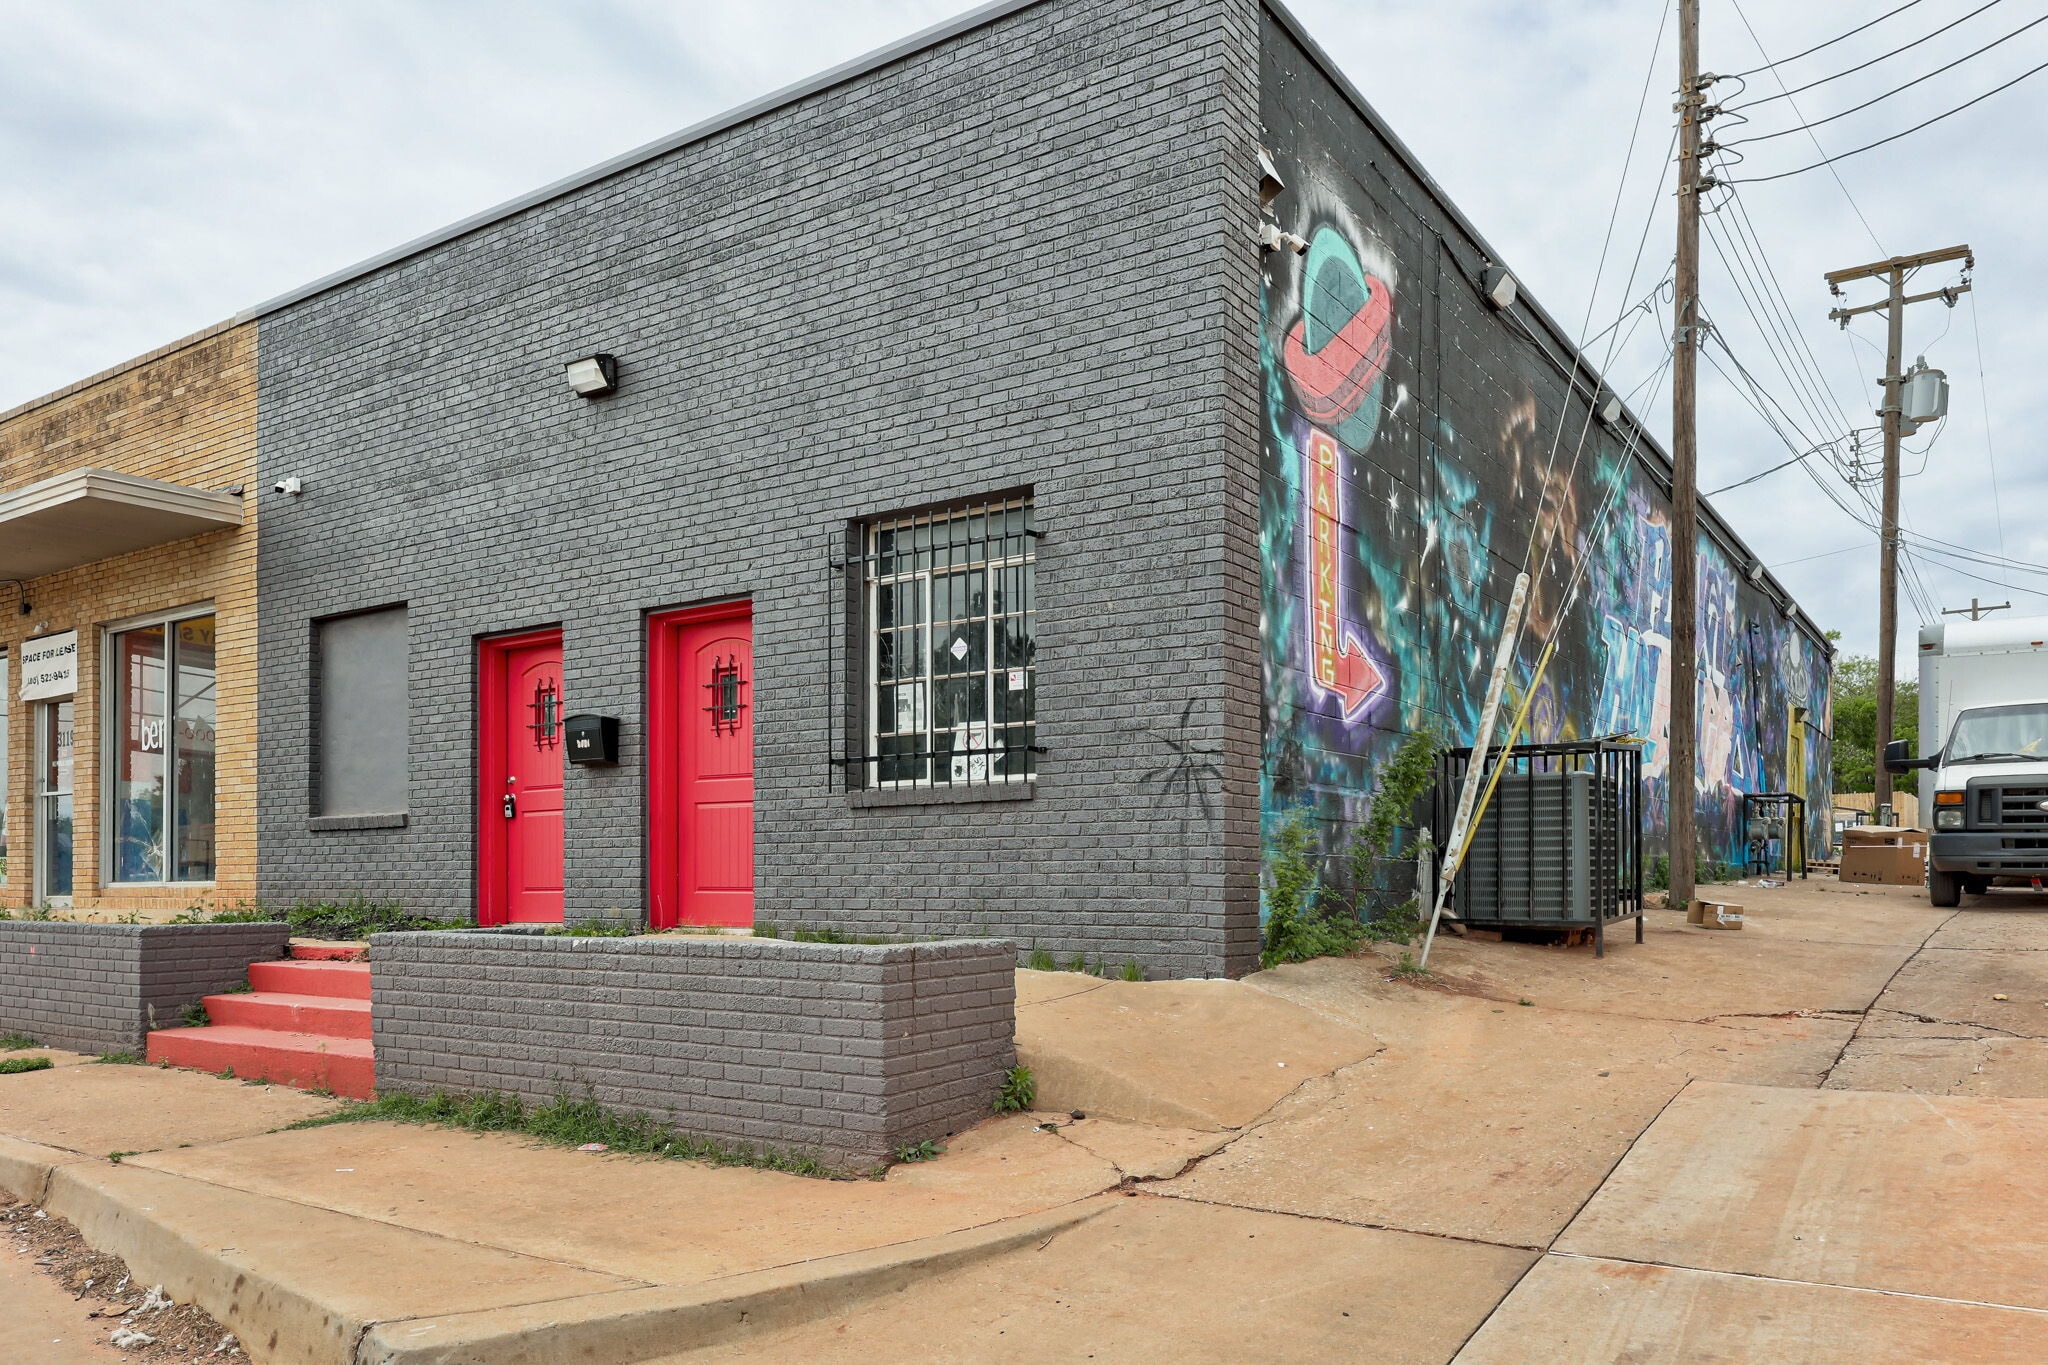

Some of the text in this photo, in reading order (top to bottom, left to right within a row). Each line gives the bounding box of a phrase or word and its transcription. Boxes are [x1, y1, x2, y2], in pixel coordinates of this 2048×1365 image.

[1317, 443, 1335, 687] PARKING
[22, 643, 76, 664] SPACE FOR LEASE
